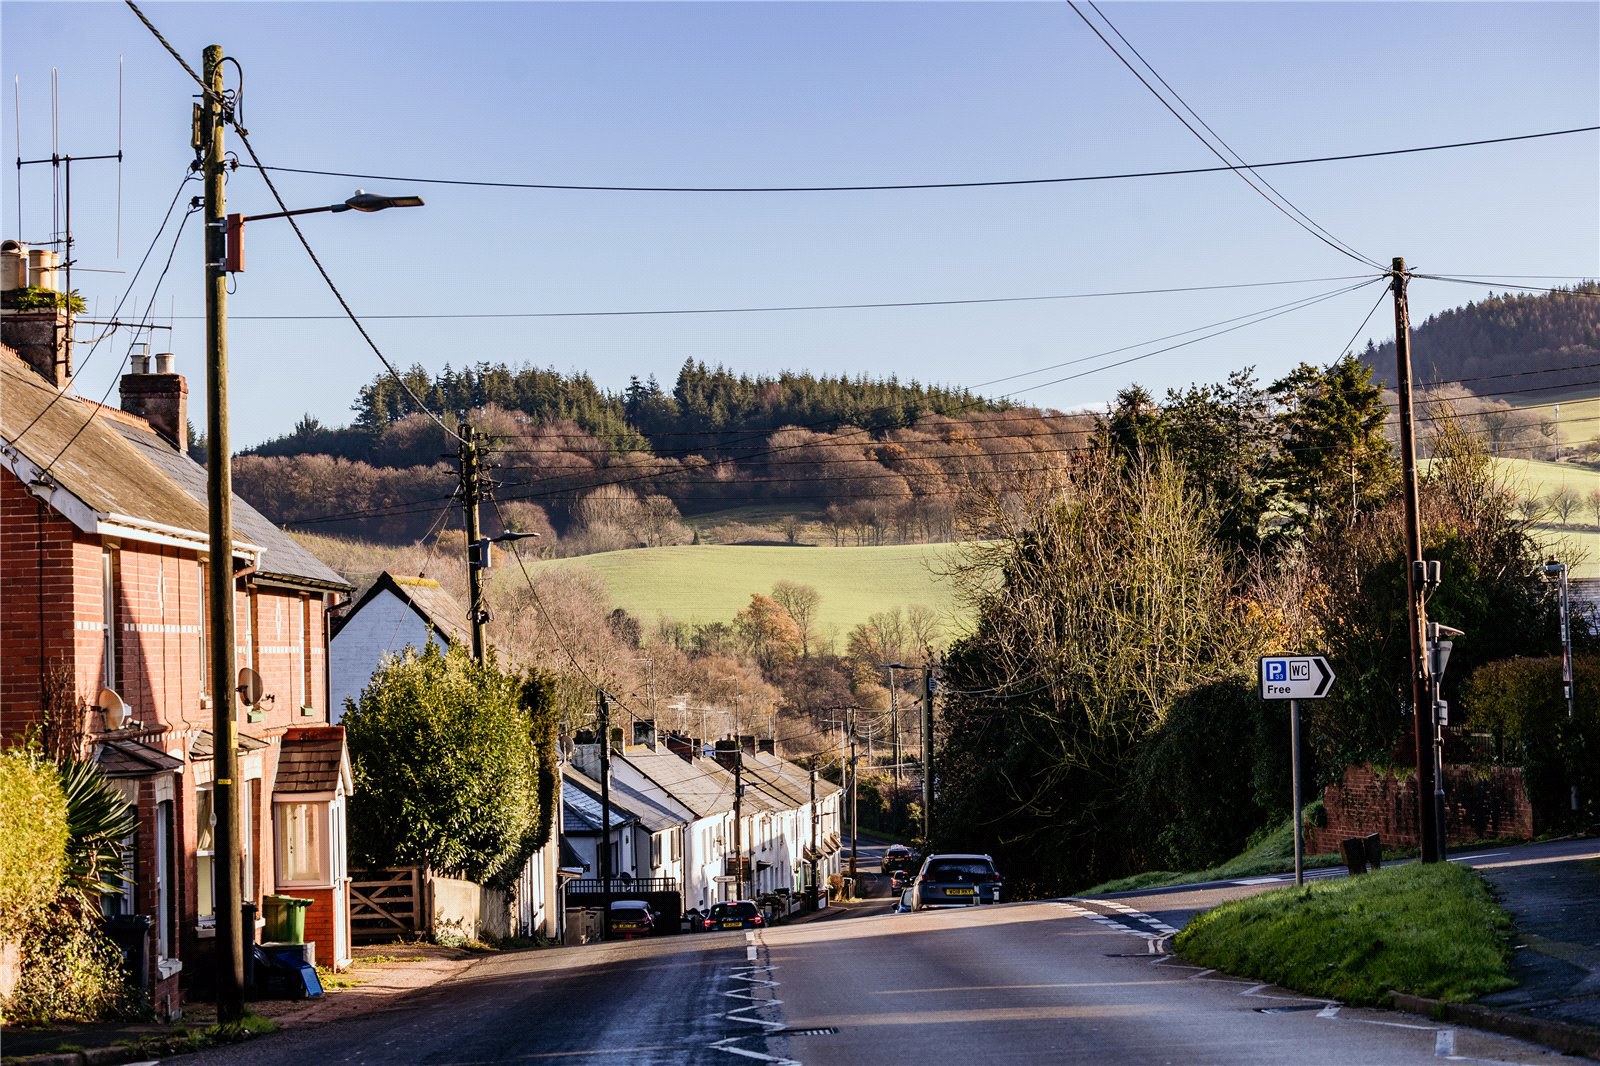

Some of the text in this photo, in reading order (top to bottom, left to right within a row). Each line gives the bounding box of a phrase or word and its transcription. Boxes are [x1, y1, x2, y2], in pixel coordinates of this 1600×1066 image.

[1269, 663, 1282, 680] P
[1292, 665, 1307, 676] WC
[1267, 685, 1291, 694] Free
